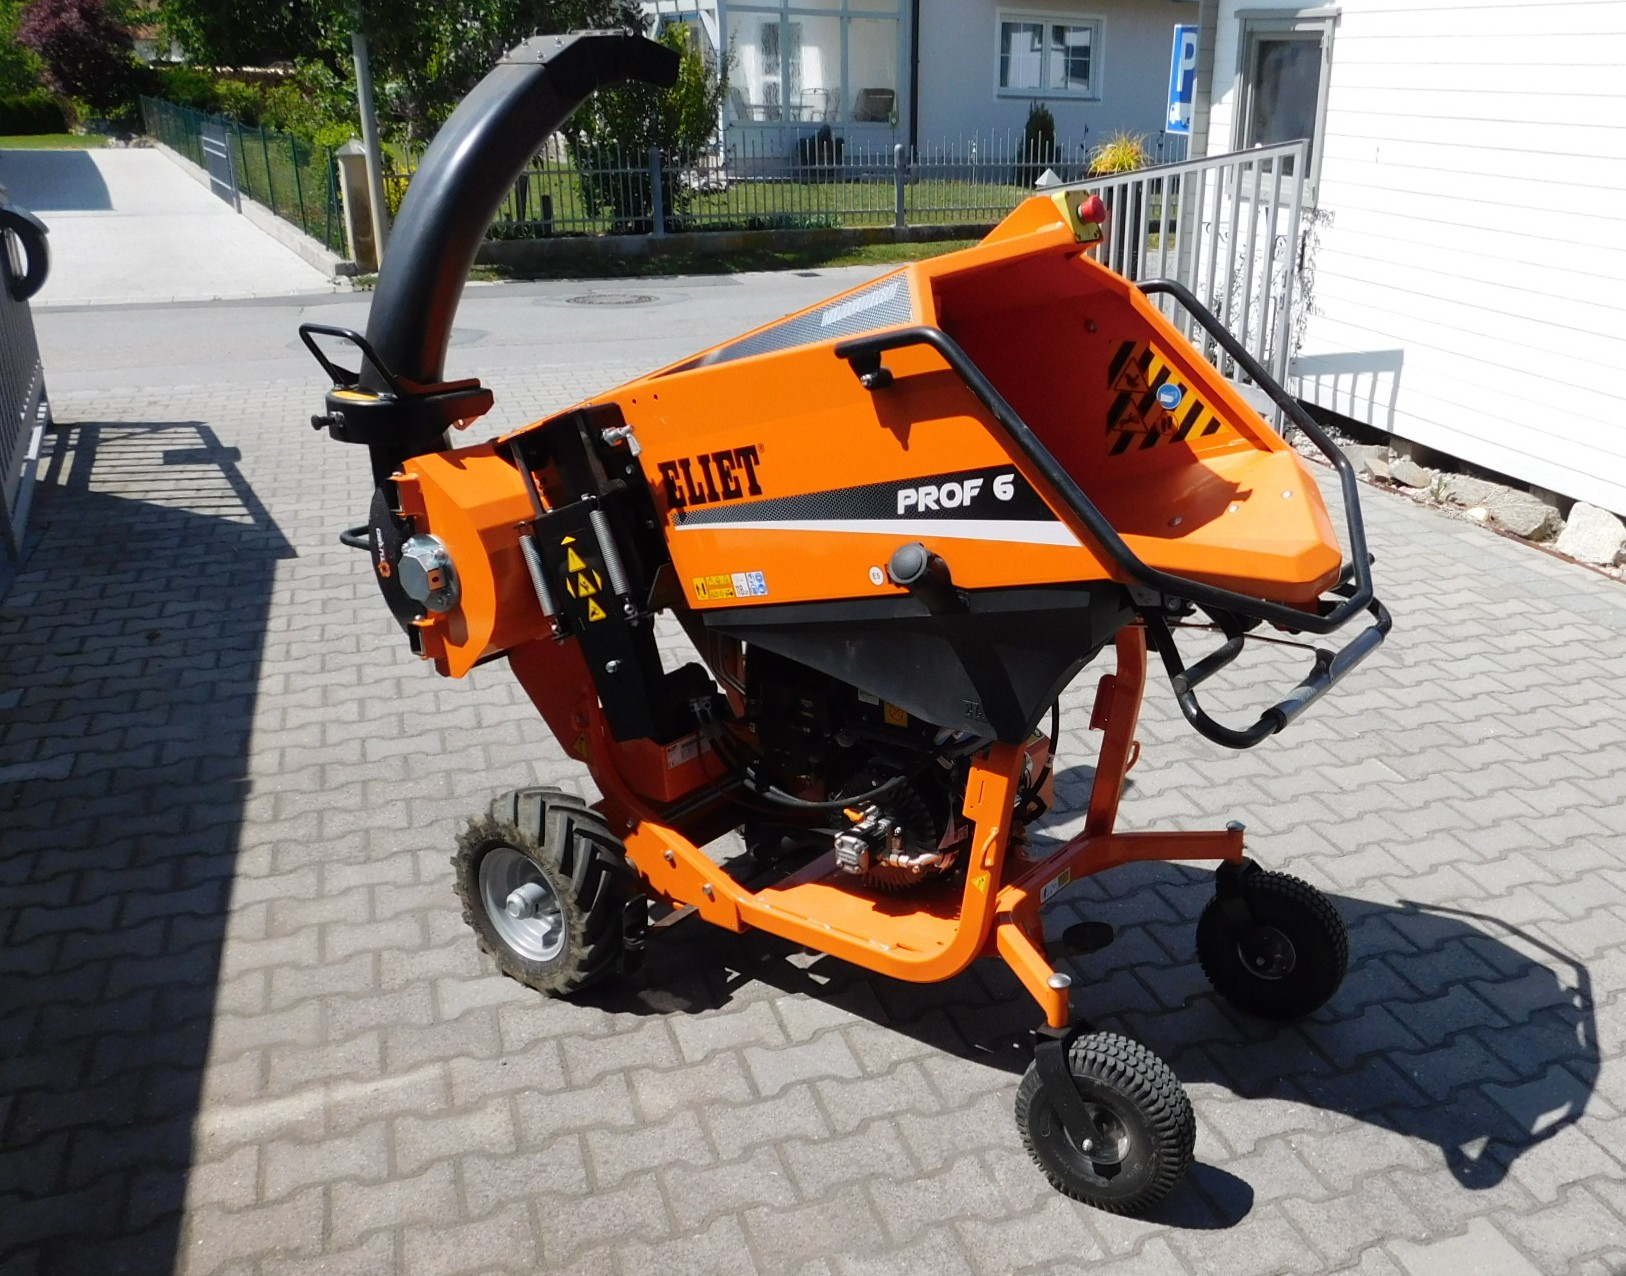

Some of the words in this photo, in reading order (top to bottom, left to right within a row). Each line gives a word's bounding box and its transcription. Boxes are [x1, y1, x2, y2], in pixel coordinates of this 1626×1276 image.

[1177, 31, 1198, 92] P
[657, 444, 763, 508] ELIET
[897, 478, 984, 515] PROF
[992, 473, 1015, 502] 6
